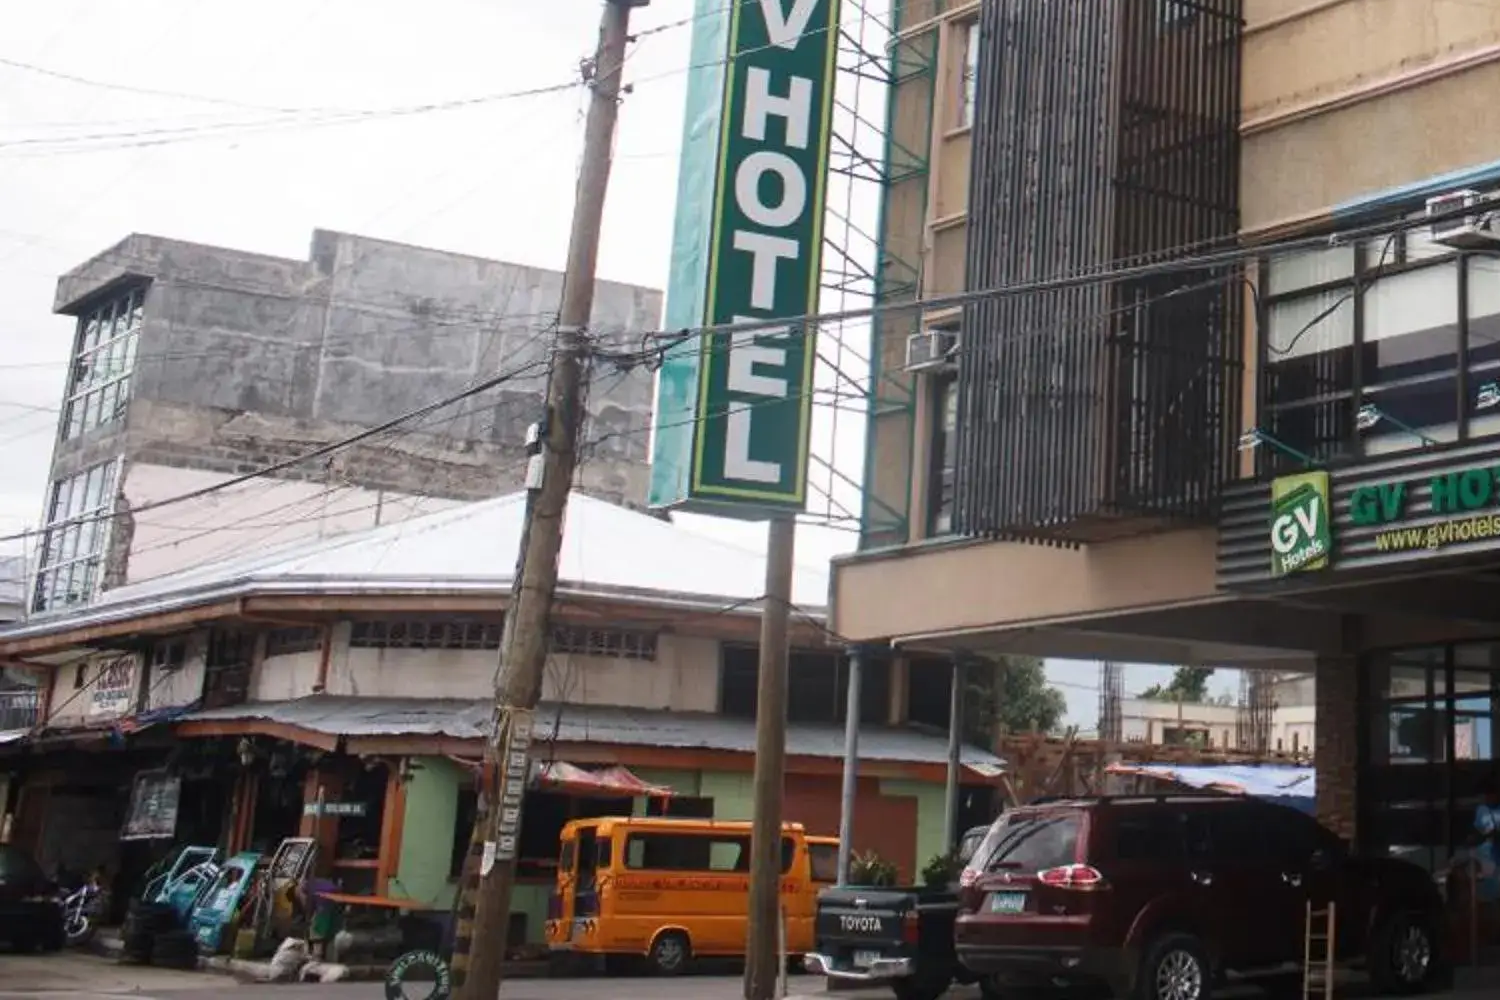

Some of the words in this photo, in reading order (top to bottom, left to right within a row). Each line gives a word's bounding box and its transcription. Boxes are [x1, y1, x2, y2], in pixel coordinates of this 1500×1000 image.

[722, 67, 812, 485] HOTEL
[1272, 496, 1318, 554] GV
[1351, 481, 1405, 526] GV
[1281, 539, 1324, 574] Hotels
[840, 915, 882, 932] TOYOTA
